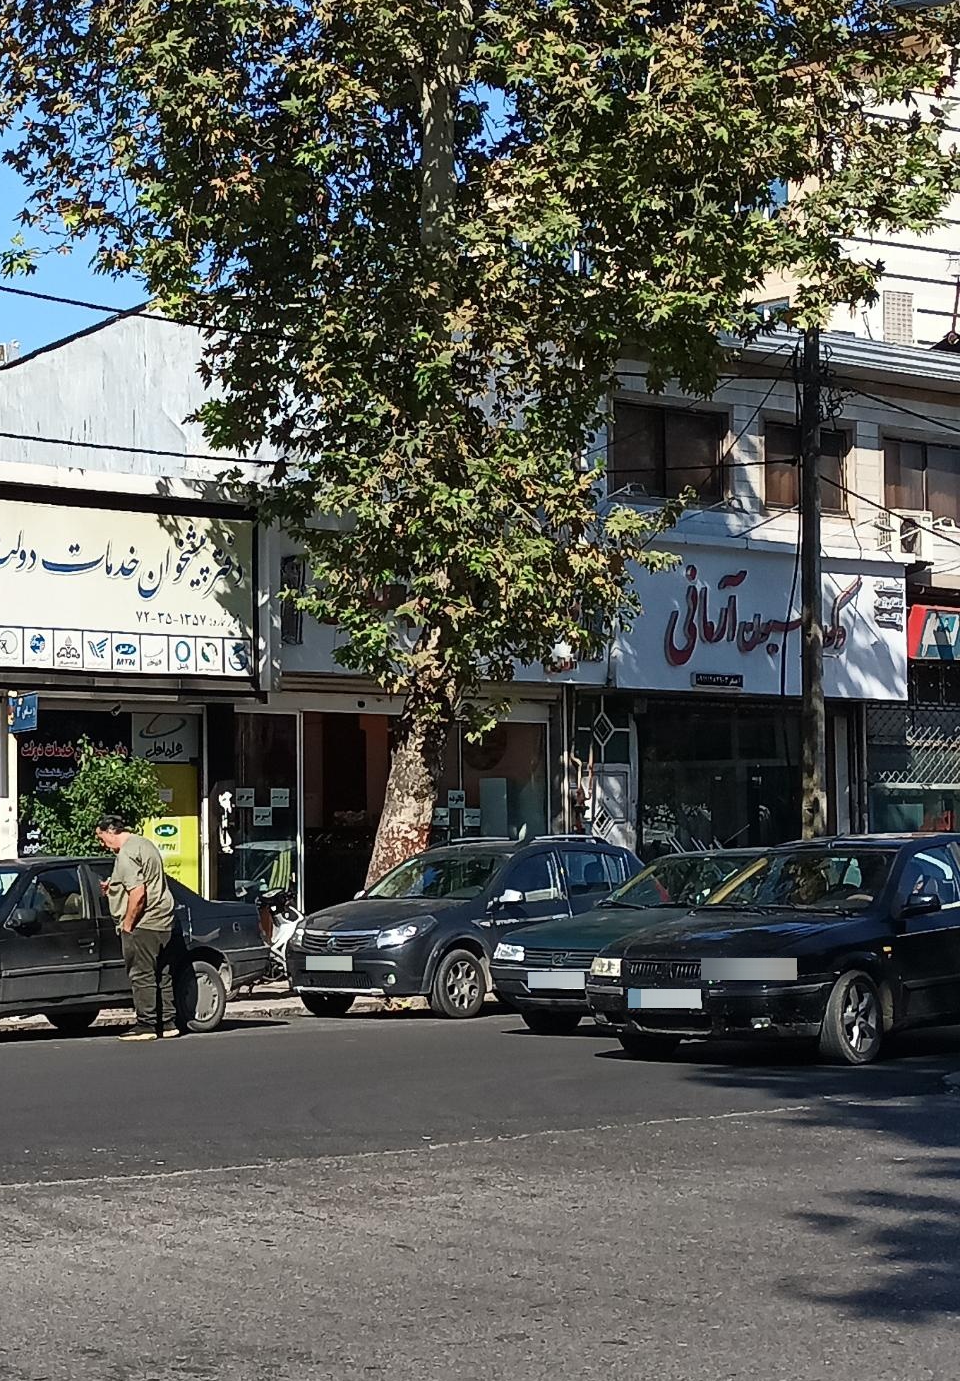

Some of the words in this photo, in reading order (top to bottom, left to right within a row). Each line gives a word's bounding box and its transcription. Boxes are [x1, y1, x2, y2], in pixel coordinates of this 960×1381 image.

[41, 538, 139, 577] خدمات
[138, 524, 210, 598] پیشخوان
[202, 535, 244, 598] دفتر
[663, 564, 748, 667] آرمانی
[738, 575, 863, 654] دکوسیون
